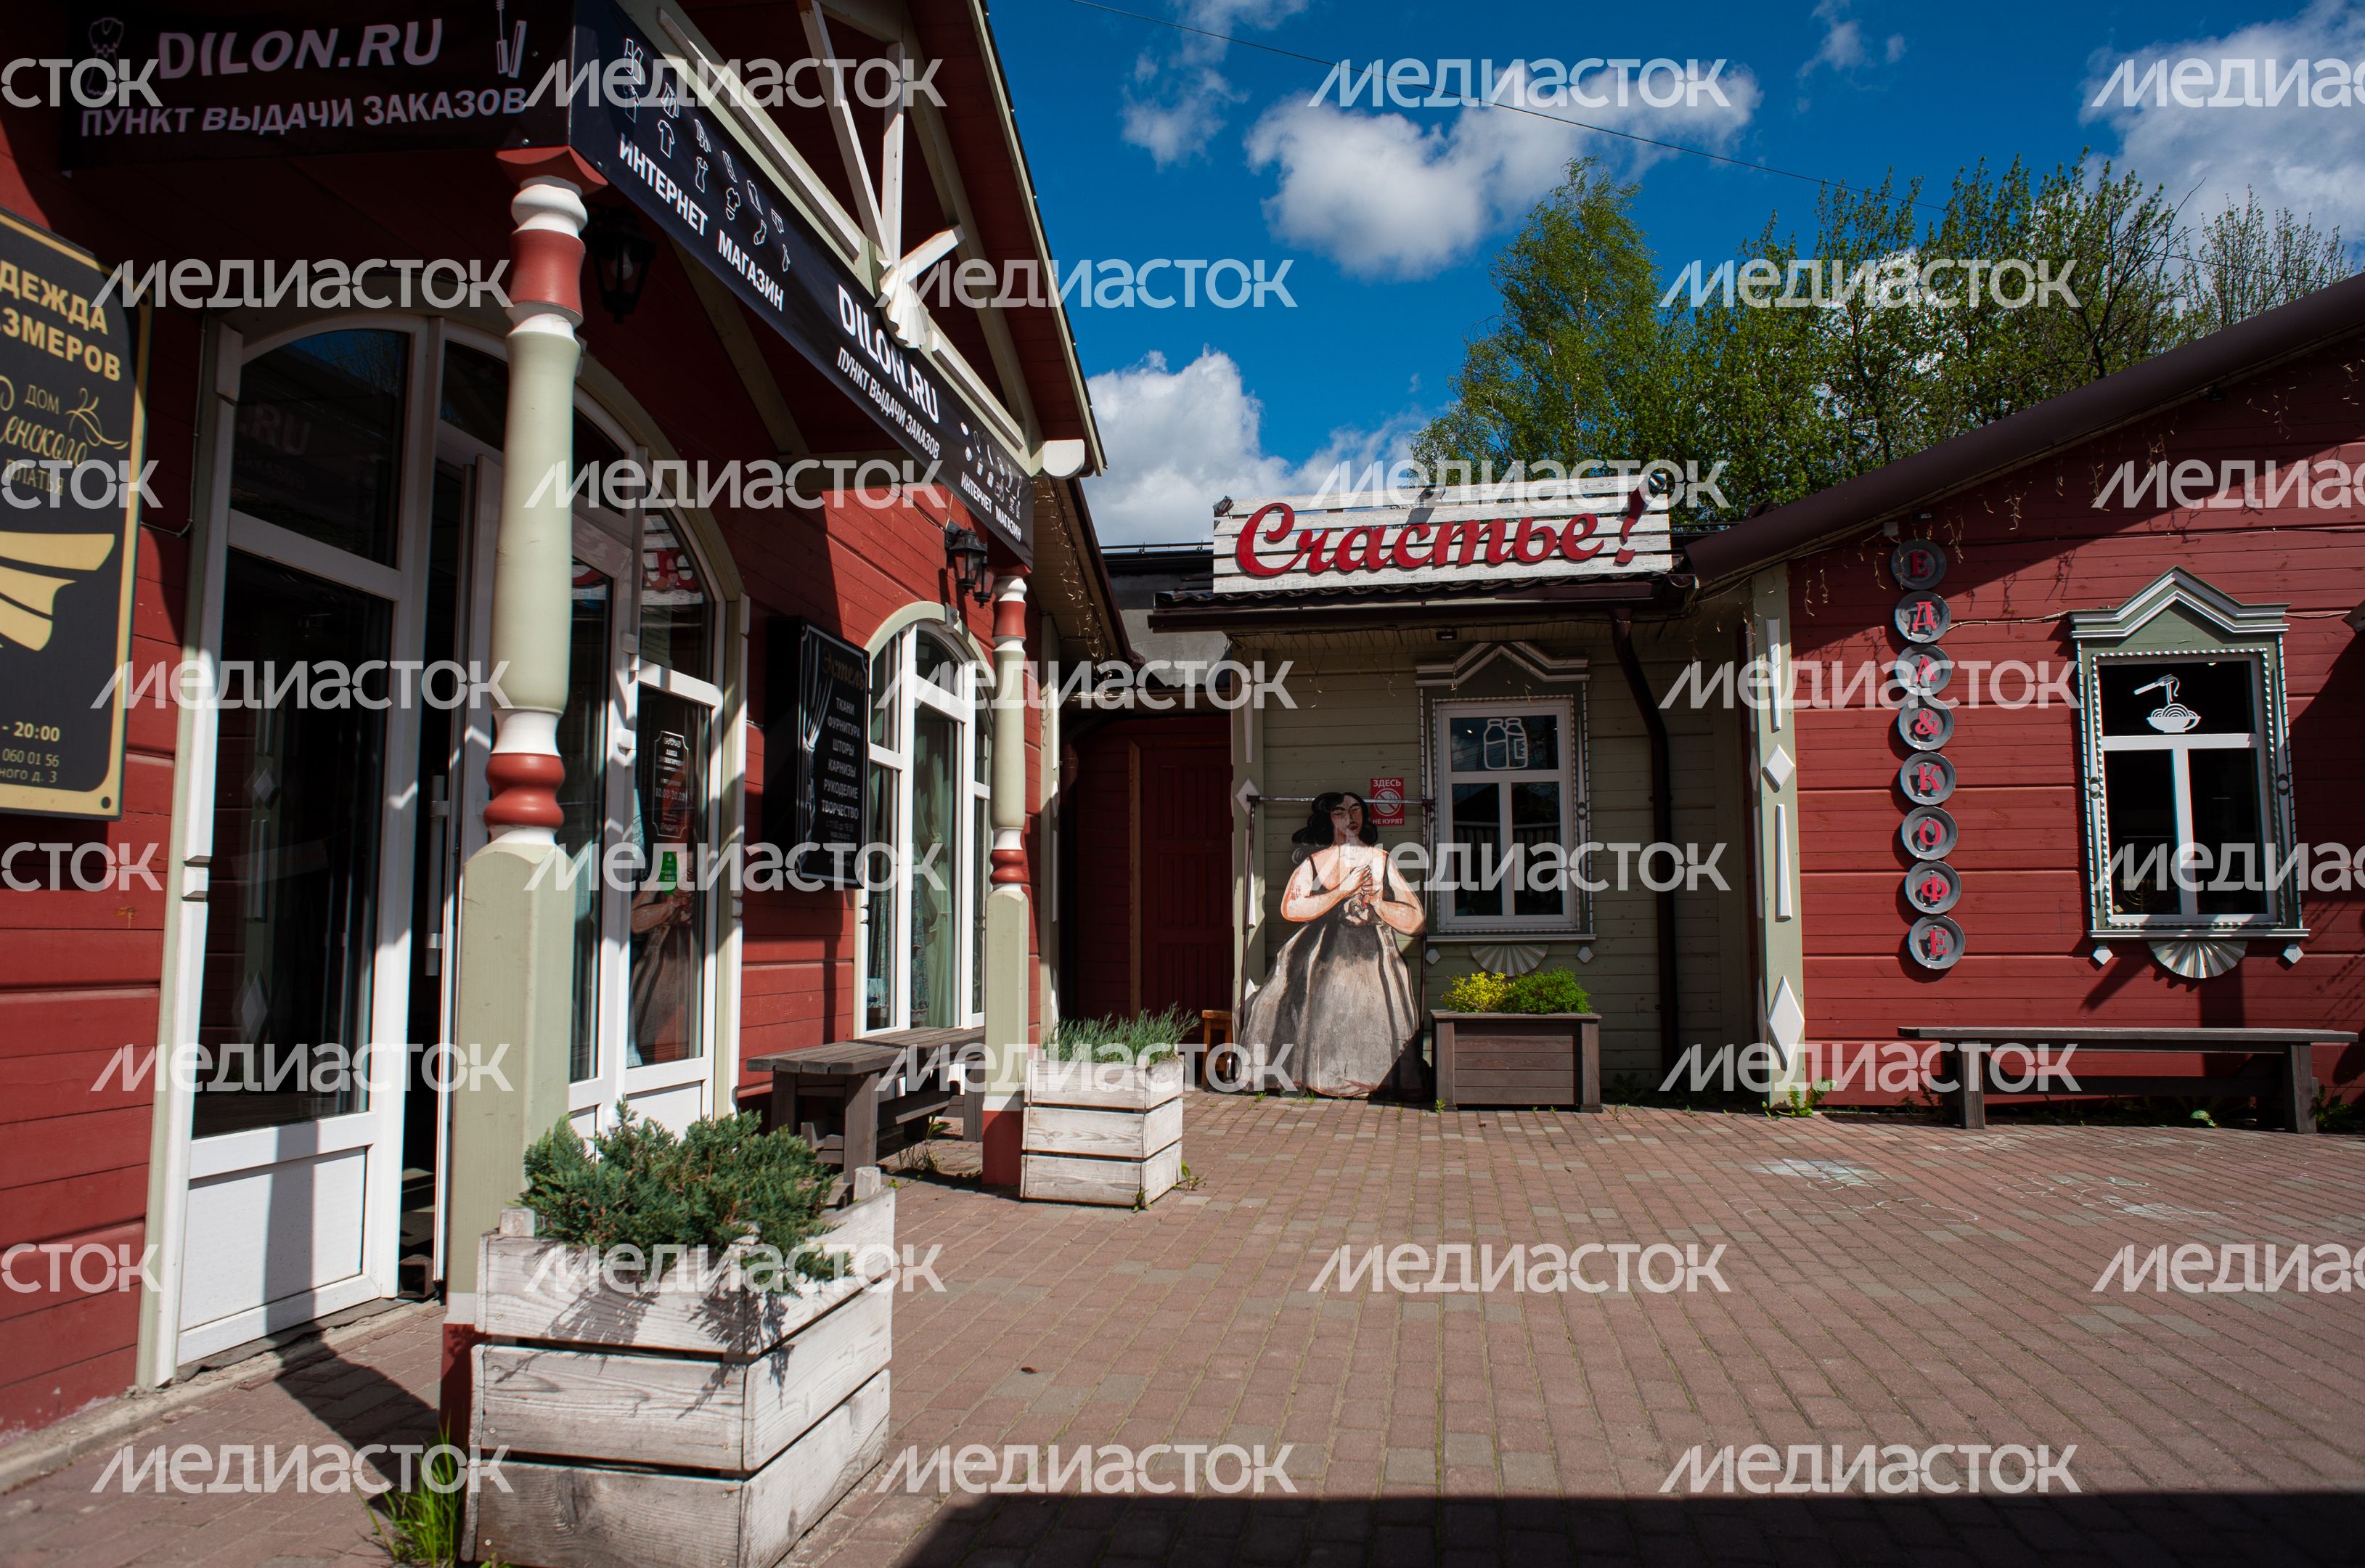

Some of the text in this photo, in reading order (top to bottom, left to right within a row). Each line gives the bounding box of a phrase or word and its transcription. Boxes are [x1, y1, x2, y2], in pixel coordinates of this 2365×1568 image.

[158, 18, 443, 79] DILON.RU
[82, 88, 528, 136] ПУНКТ ВЫДАЧИ ЗАКАЗОВ
[619, 132, 785, 312] ИНТЕРНЕТ МАГАЗИН
[0, 307, 121, 381] ЗМЕРОВ
[838, 284, 939, 424] DILON.RU
[25, 384, 60, 415] ДОМ
[837, 346, 941, 460] ПУНКТ ВЫДАЧИ ЗАКАЗОВ
[0, 415, 87, 467] енского
[961, 471, 1021, 542] ИНТЕРНЕТ МАГАЗИН
[1234, 483, 1649, 578] Счастье!
[836, 697, 854, 715] ТКАНИ
[14, 721, 60, 742] 20:00
[828, 715, 861, 739] ФУРНИТУРА
[28, 751, 41, 765] 01
[45, 754, 60, 767] 56
[833, 738, 855, 757] ШТОРЫ
[49, 771, 57, 783] 3
[828, 758, 857, 778] КАРНИЗЫ
[824, 778, 859, 799] РУКОДЕЛИЕ
[1373, 779, 1401, 788] ЗДЕСЬ
[822, 799, 859, 820] ТВОРЧЕСТВО
